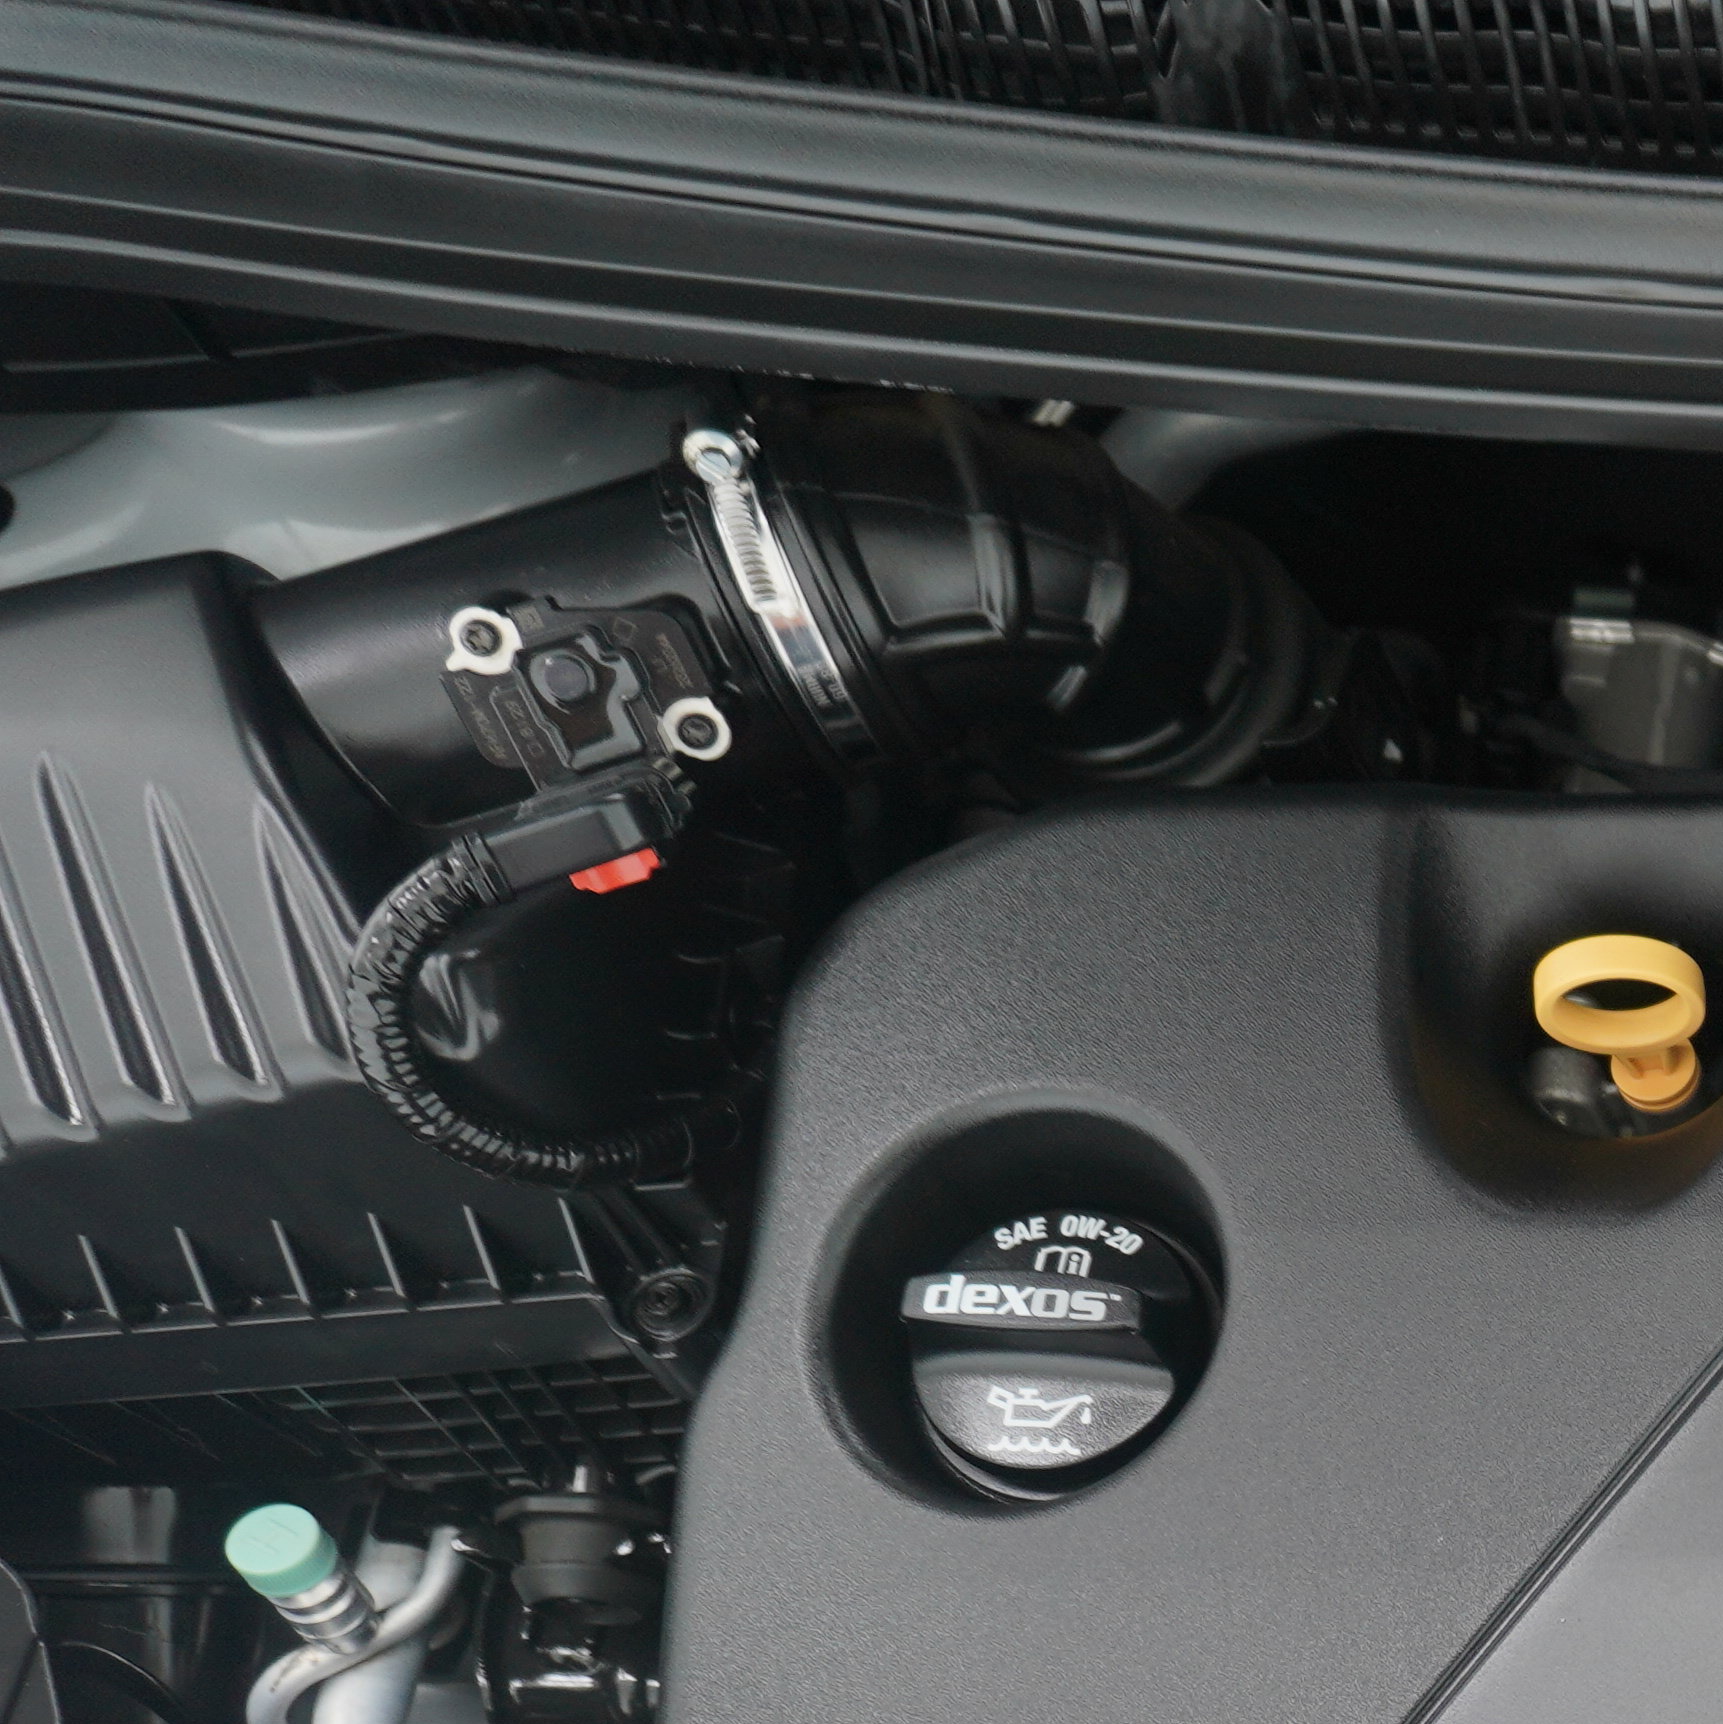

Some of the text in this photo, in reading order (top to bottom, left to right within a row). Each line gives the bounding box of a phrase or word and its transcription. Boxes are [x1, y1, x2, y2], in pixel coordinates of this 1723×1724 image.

[994, 1215, 1144, 1256] SAE 0W-20
[923, 1274, 1107, 1321] dexos
